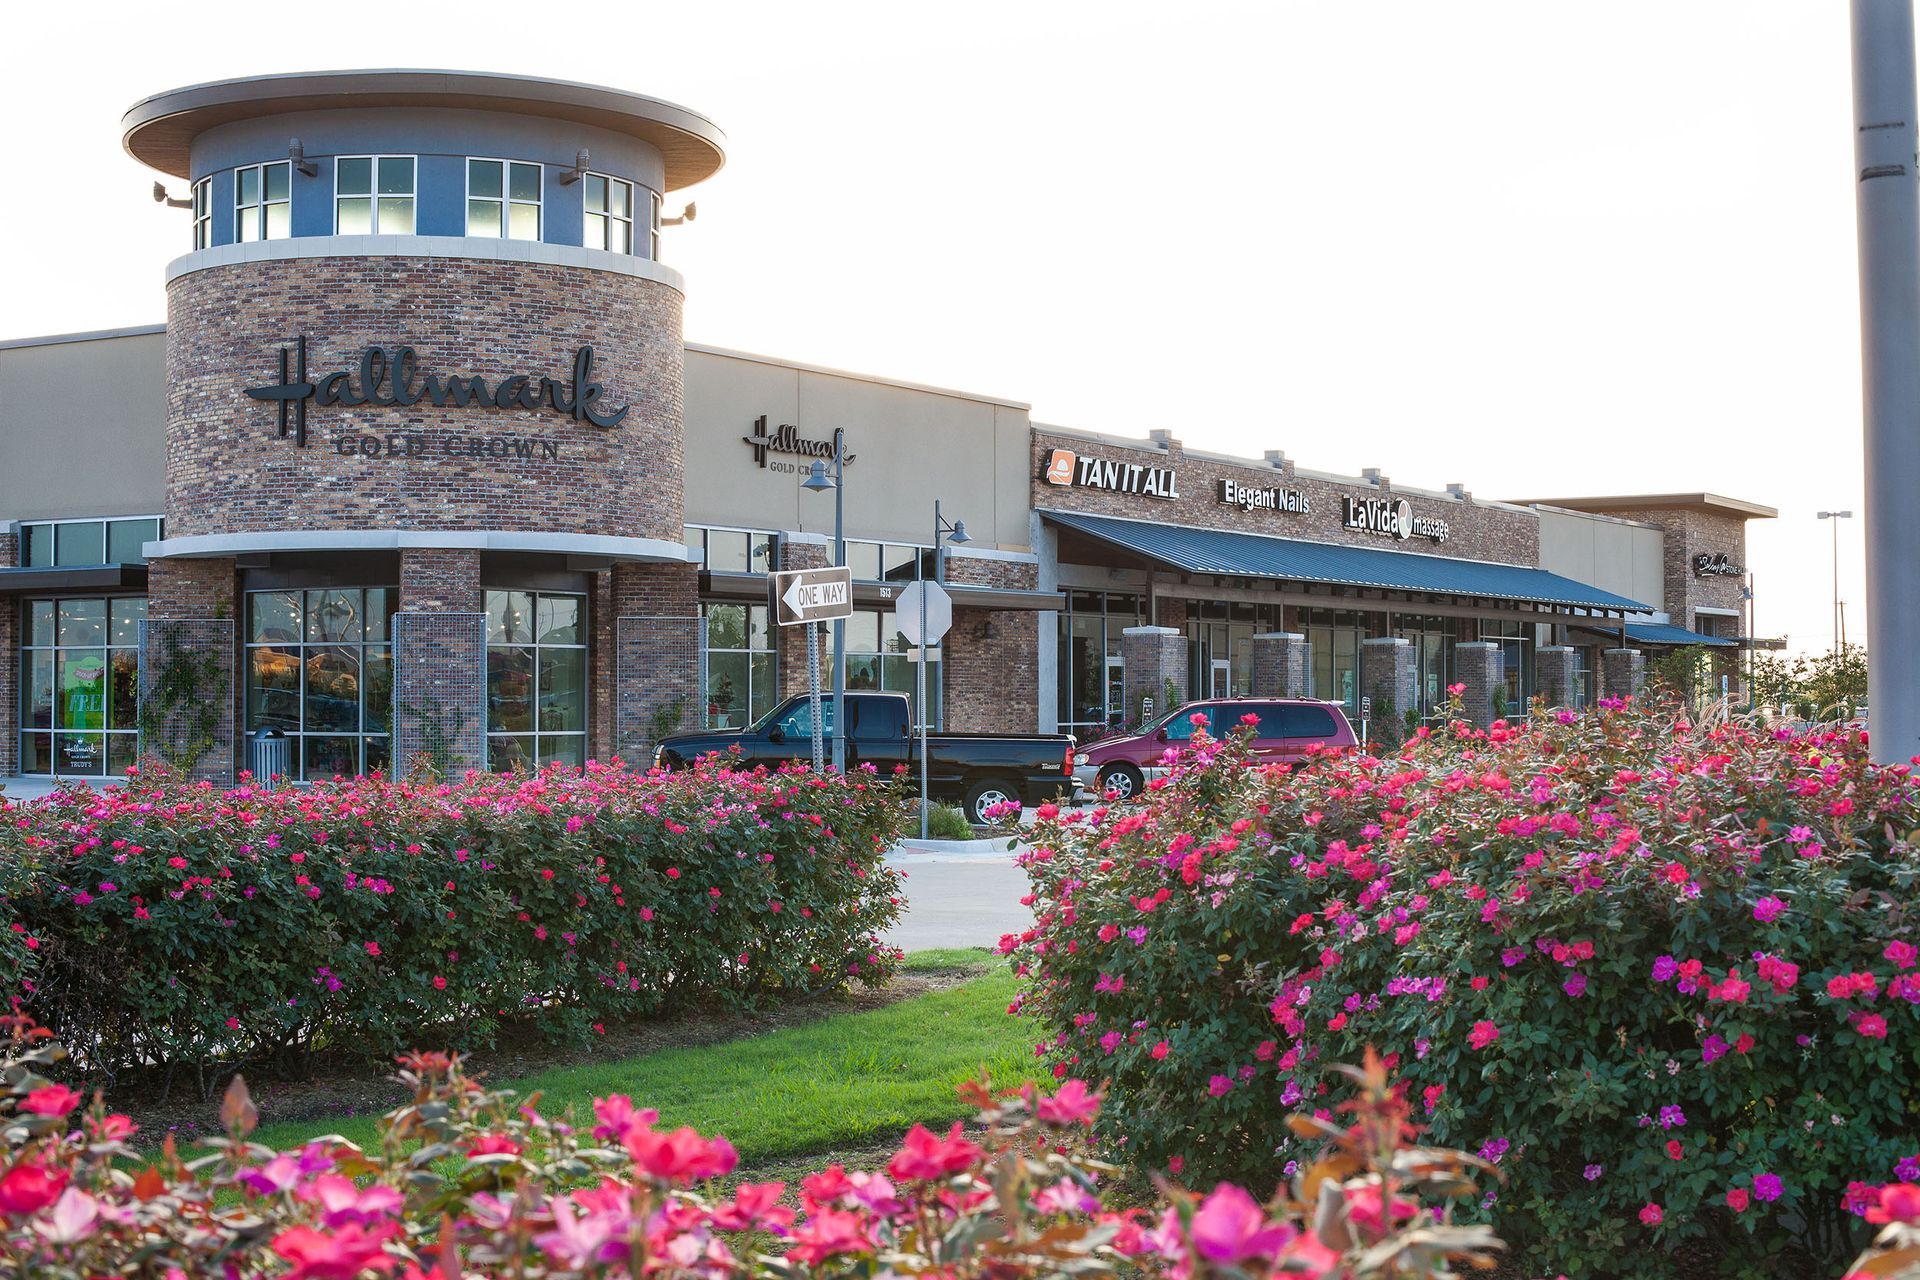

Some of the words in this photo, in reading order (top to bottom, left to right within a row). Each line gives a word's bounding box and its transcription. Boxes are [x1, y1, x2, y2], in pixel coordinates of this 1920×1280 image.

[243, 335, 630, 448] Hallmark
[335, 434, 425, 458] GOLD
[444, 435, 559, 461] CROWN
[742, 415, 856, 468] Hallmark
[770, 461, 795, 474] GOLD
[1225, 480, 1276, 511] Elegant
[1279, 488, 1310, 513] Nails
[1349, 497, 1399, 534] LaVida
[1413, 518, 1449, 543] massage
[798, 586, 818, 606] ONE
[823, 583, 845, 604] WAY
